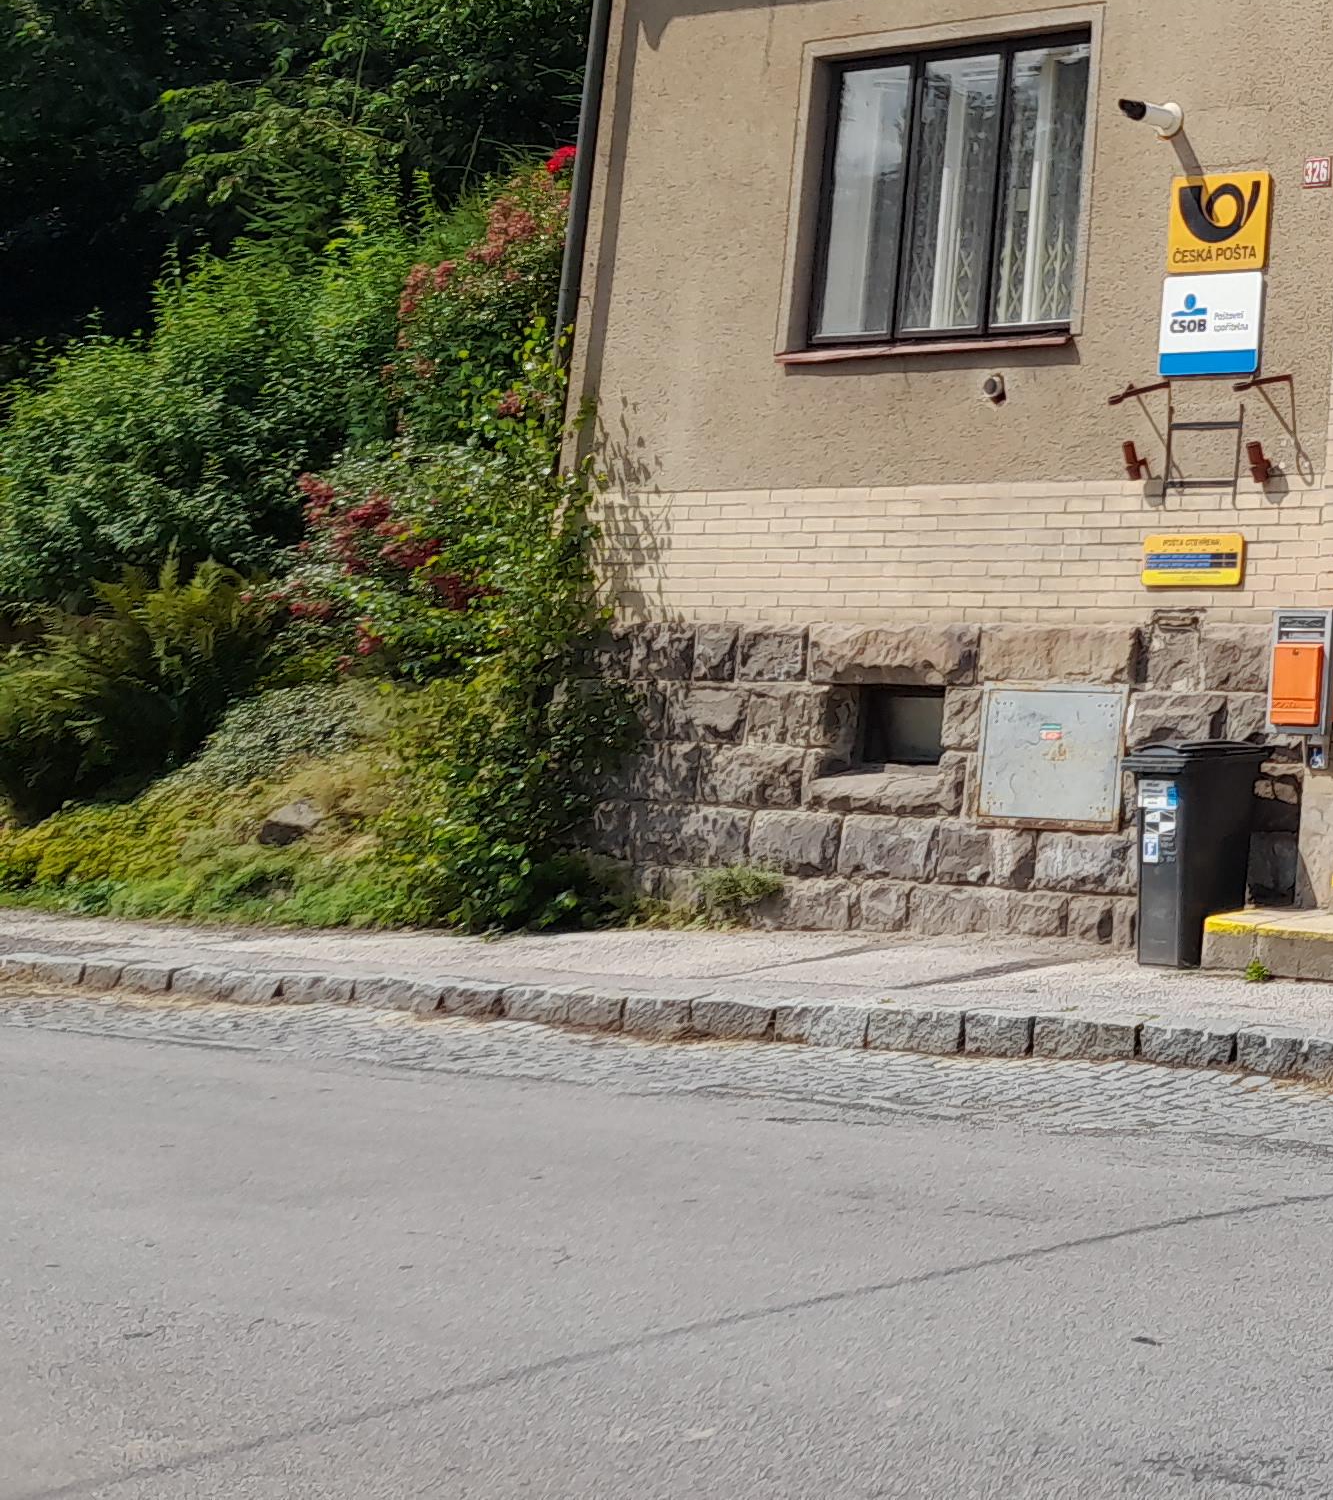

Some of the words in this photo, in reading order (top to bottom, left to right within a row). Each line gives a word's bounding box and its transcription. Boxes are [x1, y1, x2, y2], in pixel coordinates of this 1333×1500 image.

[1305, 160, 1328, 183] 326
[1172, 245, 1213, 264] ČESKÁ
[1215, 243, 1257, 261] POŠTA
[1169, 318, 1207, 334] ČSOB
